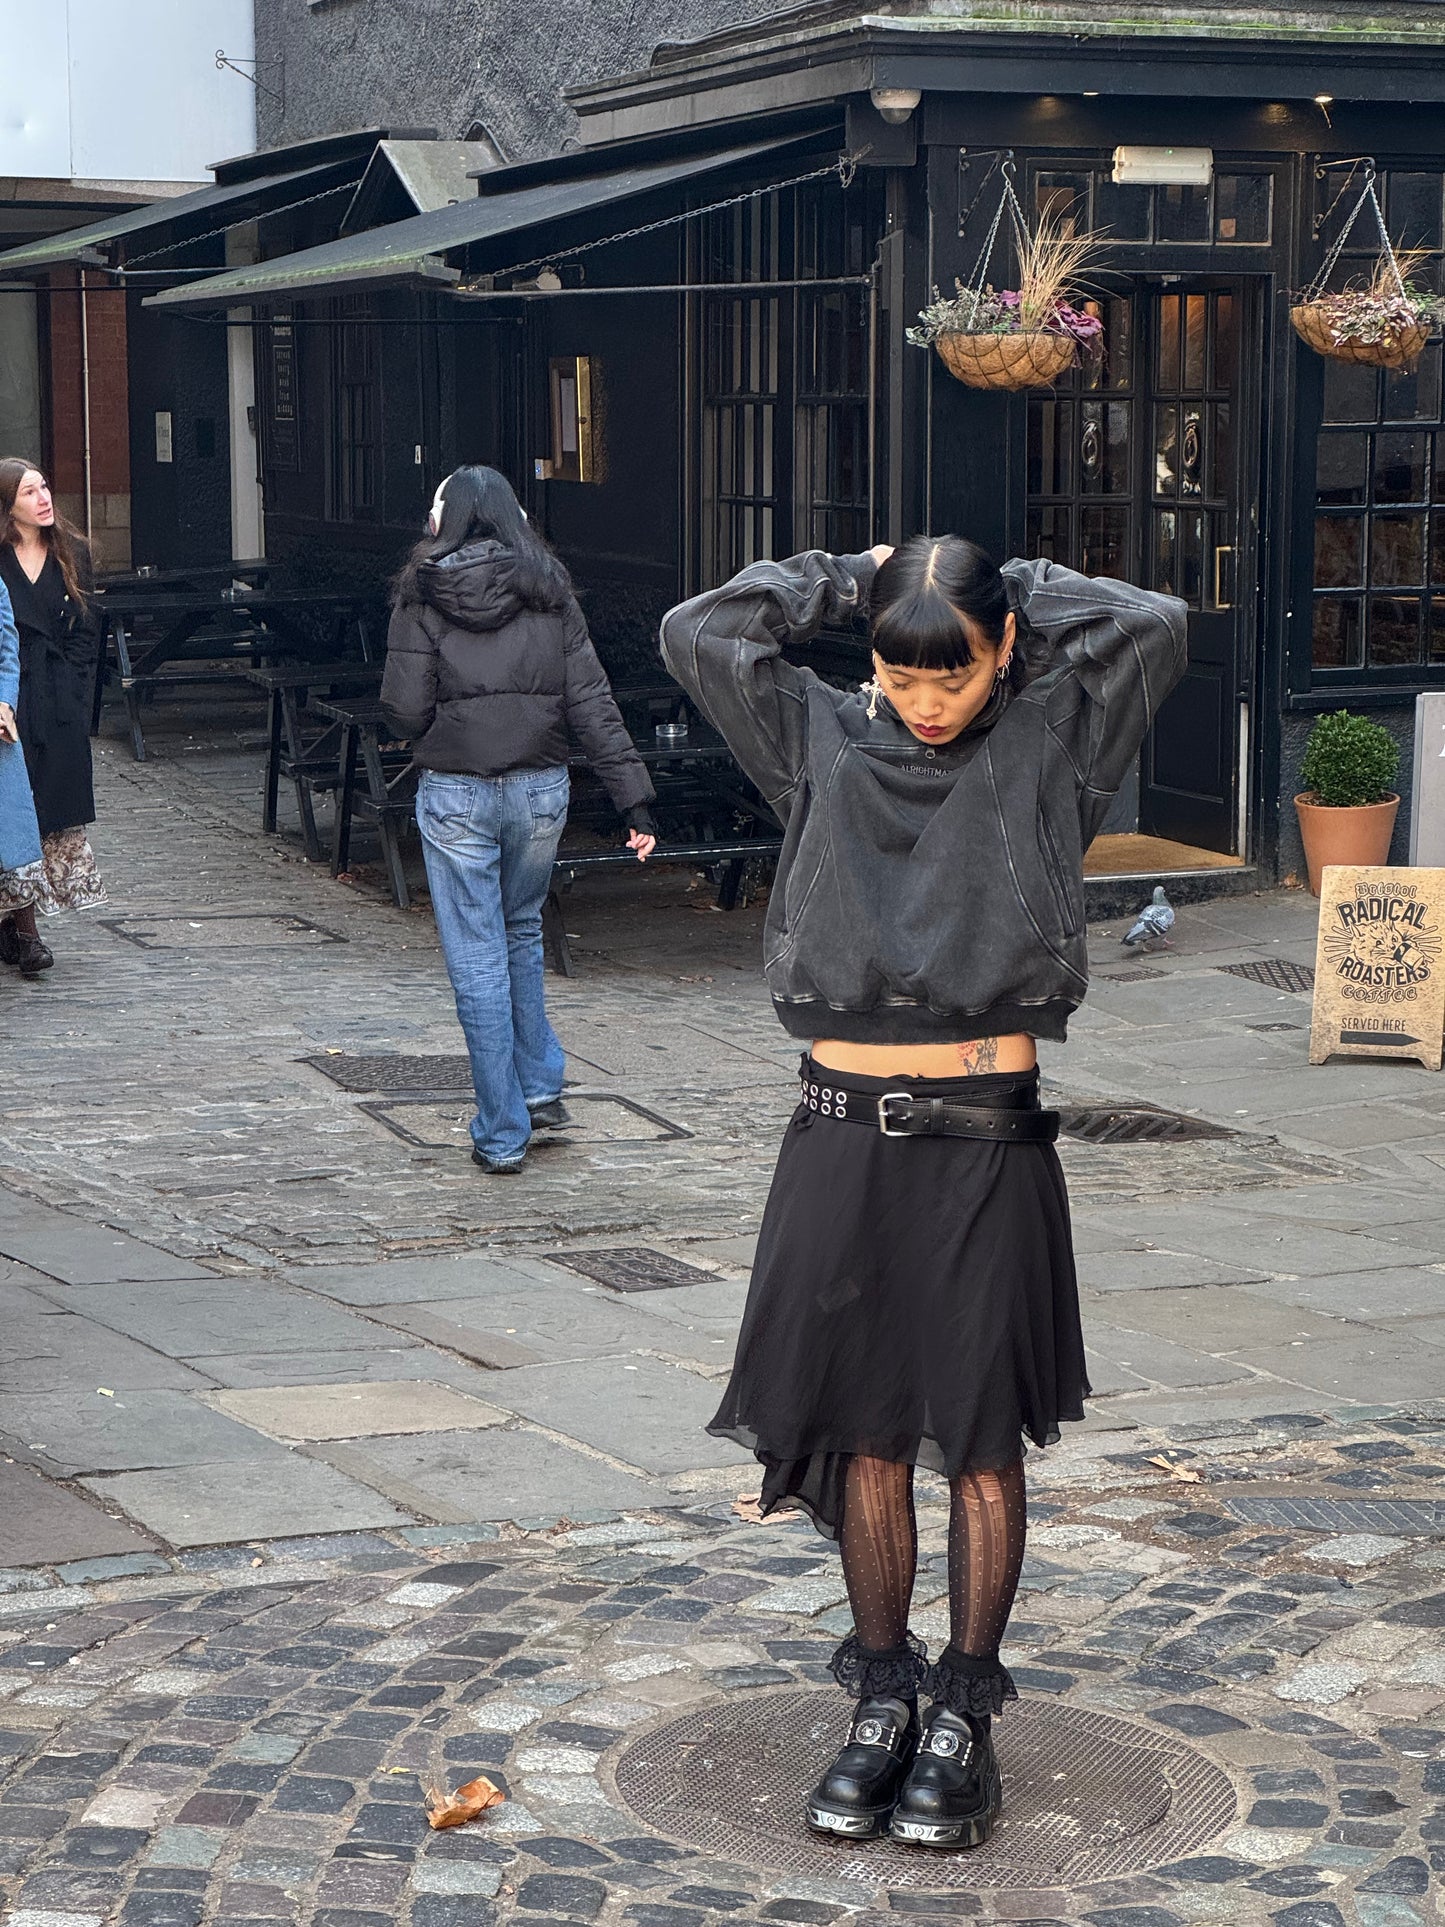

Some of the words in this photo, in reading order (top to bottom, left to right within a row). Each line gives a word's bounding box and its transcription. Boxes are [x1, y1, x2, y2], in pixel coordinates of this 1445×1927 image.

[1355, 882, 1417, 899] Bristol
[1337, 897, 1427, 930] RADICAL
[1341, 1017, 1379, 1031] SERVED
[1382, 1018, 1406, 1032] HERE
